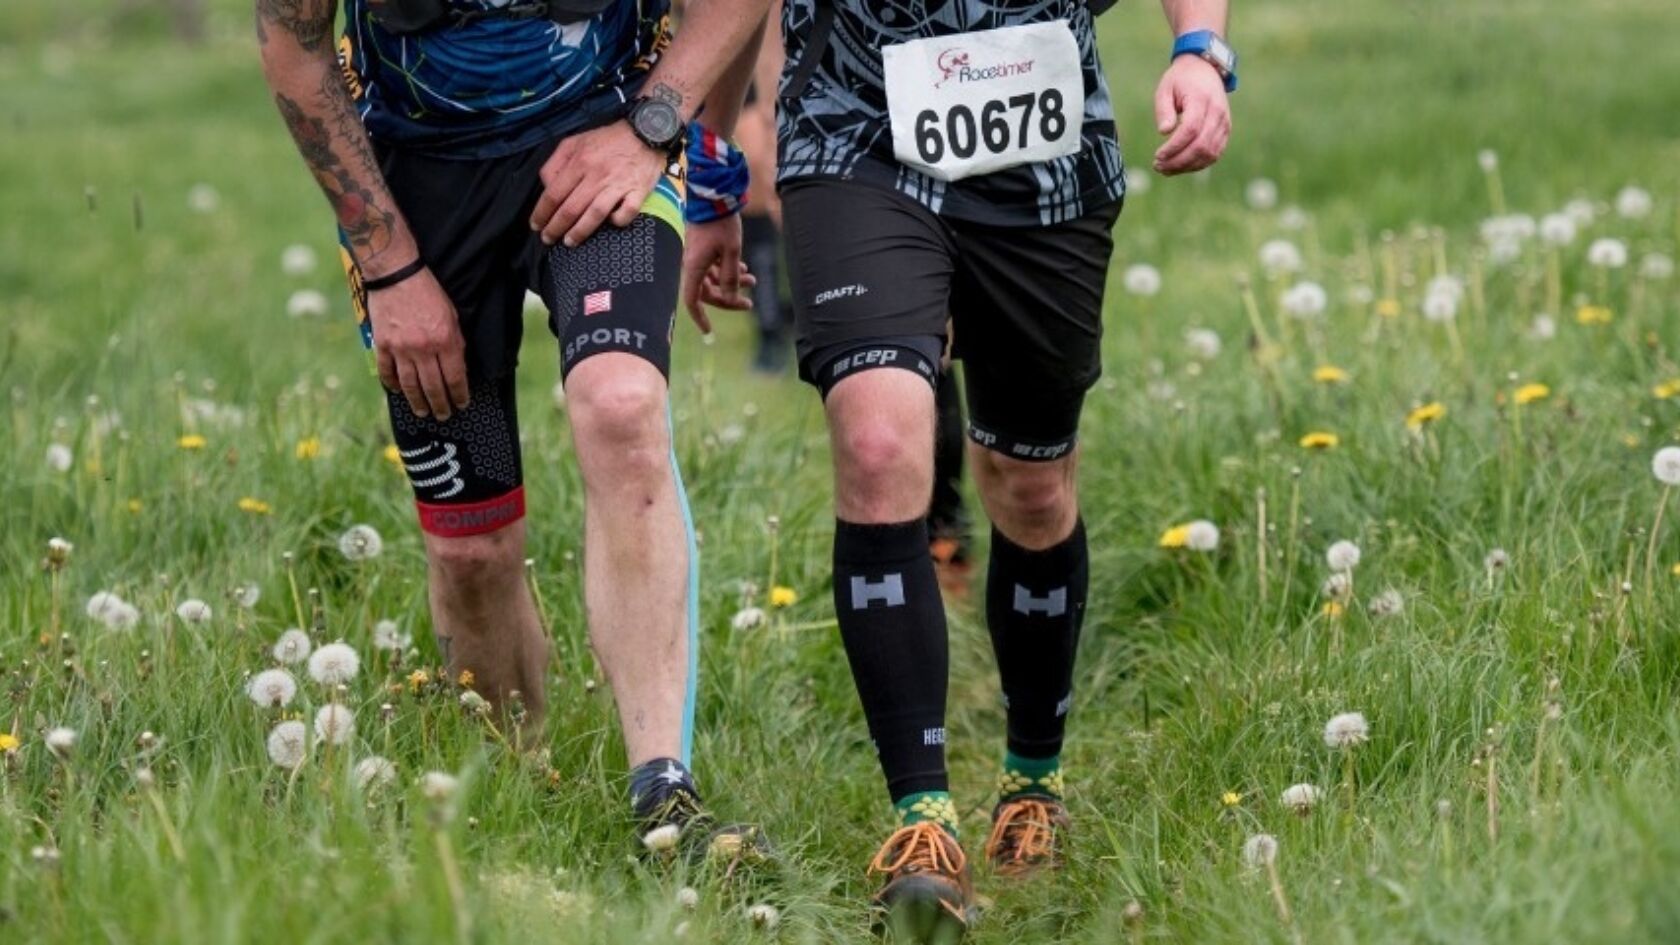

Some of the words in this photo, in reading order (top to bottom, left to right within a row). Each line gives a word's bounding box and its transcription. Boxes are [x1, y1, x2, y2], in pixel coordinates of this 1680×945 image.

[959, 59, 1035, 83] Racetimer
[915, 88, 1066, 164] 60678
[815, 285, 856, 305] CRAFT
[566, 328, 647, 360] SPORT
[852, 350, 898, 375] cep
